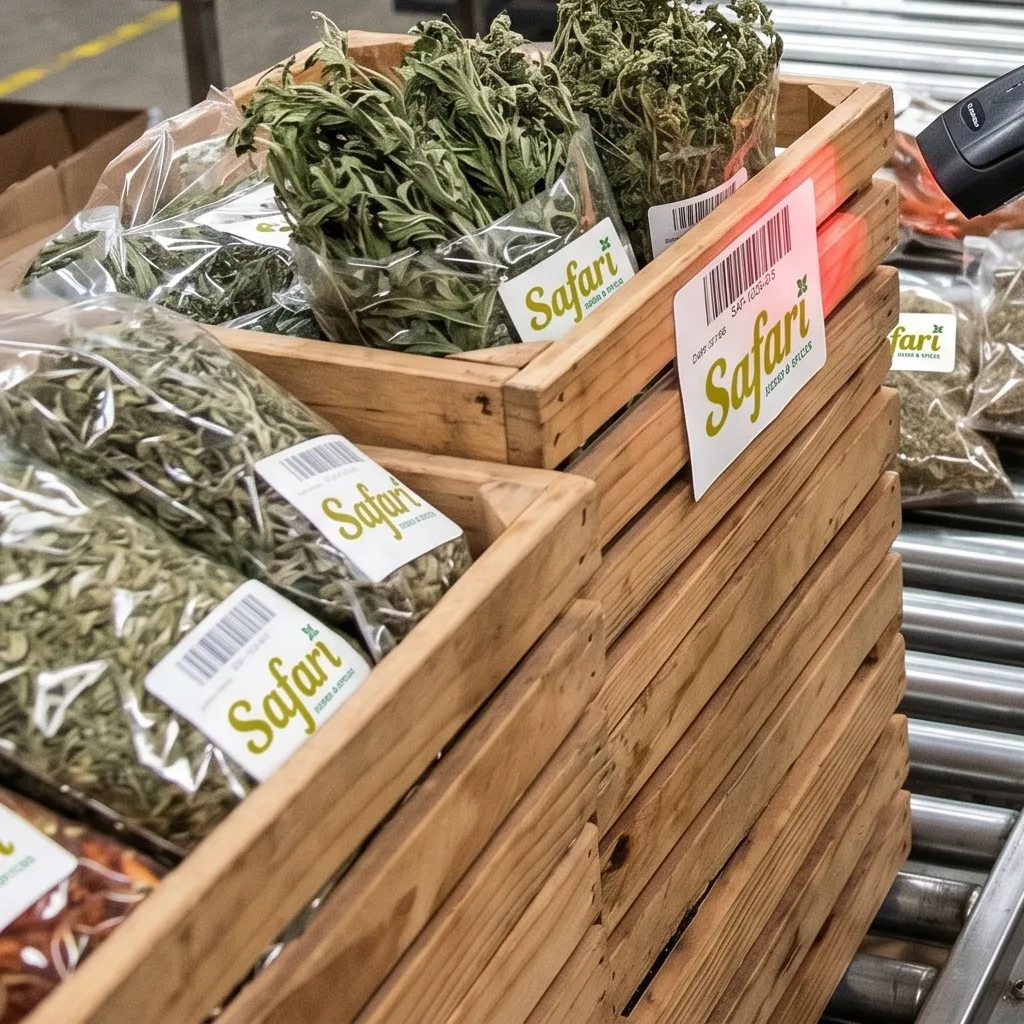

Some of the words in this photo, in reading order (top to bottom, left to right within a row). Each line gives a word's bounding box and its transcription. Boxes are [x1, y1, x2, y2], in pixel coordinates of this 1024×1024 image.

[525, 237, 618, 331] Safari
[704, 274, 810, 438] Safari
[889, 326, 941, 357] fari
[321, 478, 421, 541] Safari
[227, 624, 342, 754] Safari
